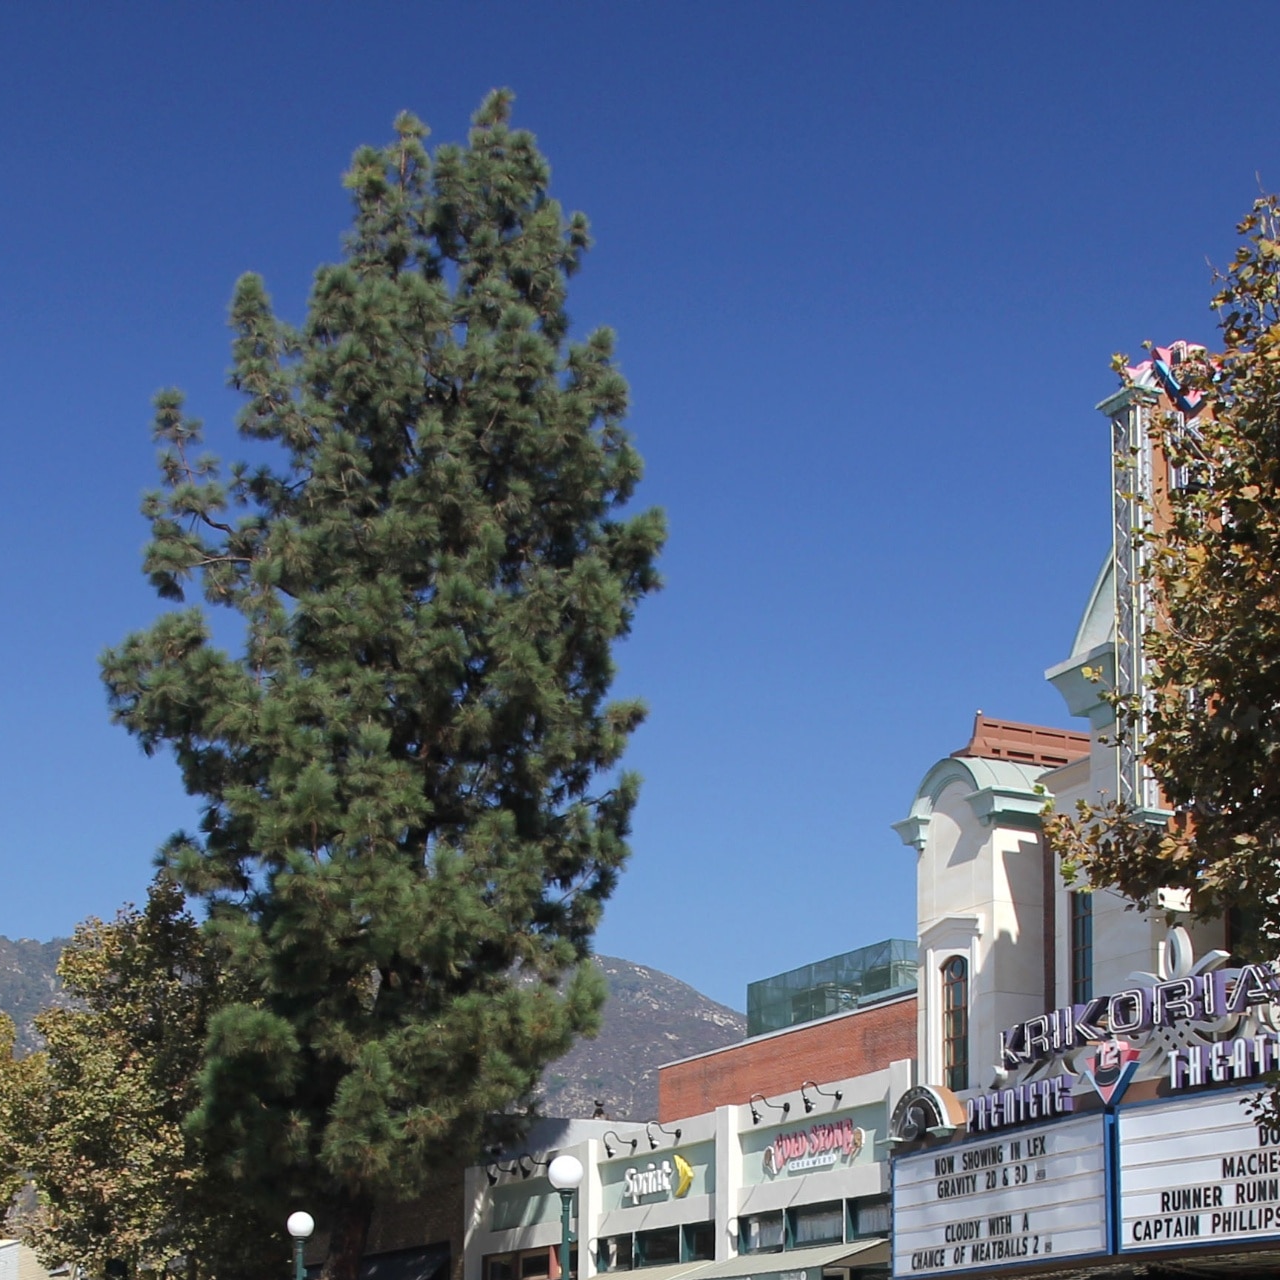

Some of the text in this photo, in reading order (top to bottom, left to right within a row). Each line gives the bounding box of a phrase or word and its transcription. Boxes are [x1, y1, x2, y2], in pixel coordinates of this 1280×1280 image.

[966, 1075, 1065, 1134] PREMIERE
[774, 1118, 853, 1169] COLD STONE
[934, 1135, 1046, 1177] NOW SHOWING IN LFX
[790, 1156, 833, 1169] CREAMERY
[1222, 1151, 1279, 1179] MACHE
[624, 1160, 672, 1205] Sprint
[937, 1173, 978, 1199] GRAVITY
[986, 1170, 997, 1190] 2D
[1002, 1168, 1009, 1187] &
[1015, 1164, 1028, 1184] 3D
[1161, 1186, 1223, 1213] RUNNER
[945, 1211, 1030, 1244] CLOUDY WITH A
[1132, 1214, 1200, 1242] CAPTAIN
[911, 1248, 945, 1271] CHANCE
[953, 1245, 966, 1265] OF
[971, 1236, 1028, 1263] MEATBALLS
[1032, 1235, 1040, 1255] 2
